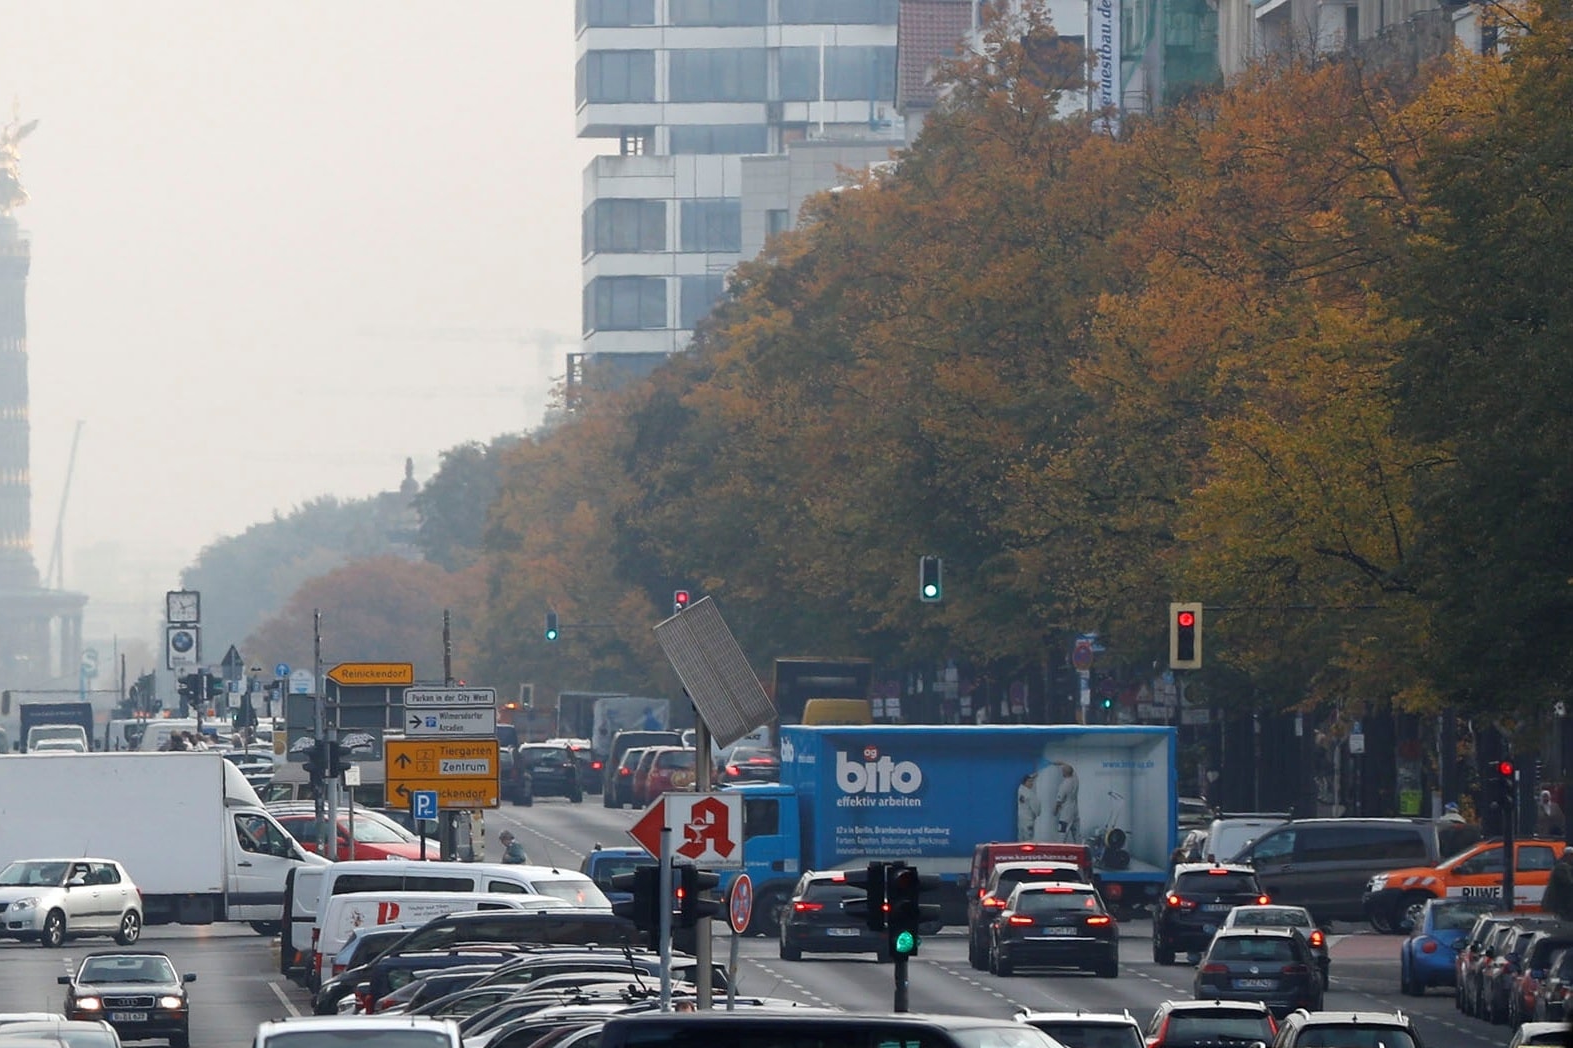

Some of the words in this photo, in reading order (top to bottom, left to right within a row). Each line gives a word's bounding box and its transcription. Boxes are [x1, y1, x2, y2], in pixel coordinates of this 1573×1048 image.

[1097, 0, 1112, 106] eruestbau.de
[342, 668, 407, 679] Reinickendorf
[412, 694, 435, 702] Parken
[437, 694, 443, 702] in
[445, 694, 456, 702] der
[458, 693, 470, 703] City
[474, 694, 489, 702] West
[439, 712, 483, 721] Wilmersdorfer
[439, 725, 464, 733] Arcaden
[440, 746, 492, 757] Tiergarten
[442, 761, 487, 772] Zentrum
[836, 751, 923, 794] bito
[438, 788, 487, 799] ickendorf
[417, 794, 430, 815] P
[837, 795, 877, 807] effektiv
[879, 795, 921, 807] arbeiten
[875, 826, 911, 836] Brandenburg
[912, 826, 923, 834] und
[924, 826, 950, 836] Hamburg
